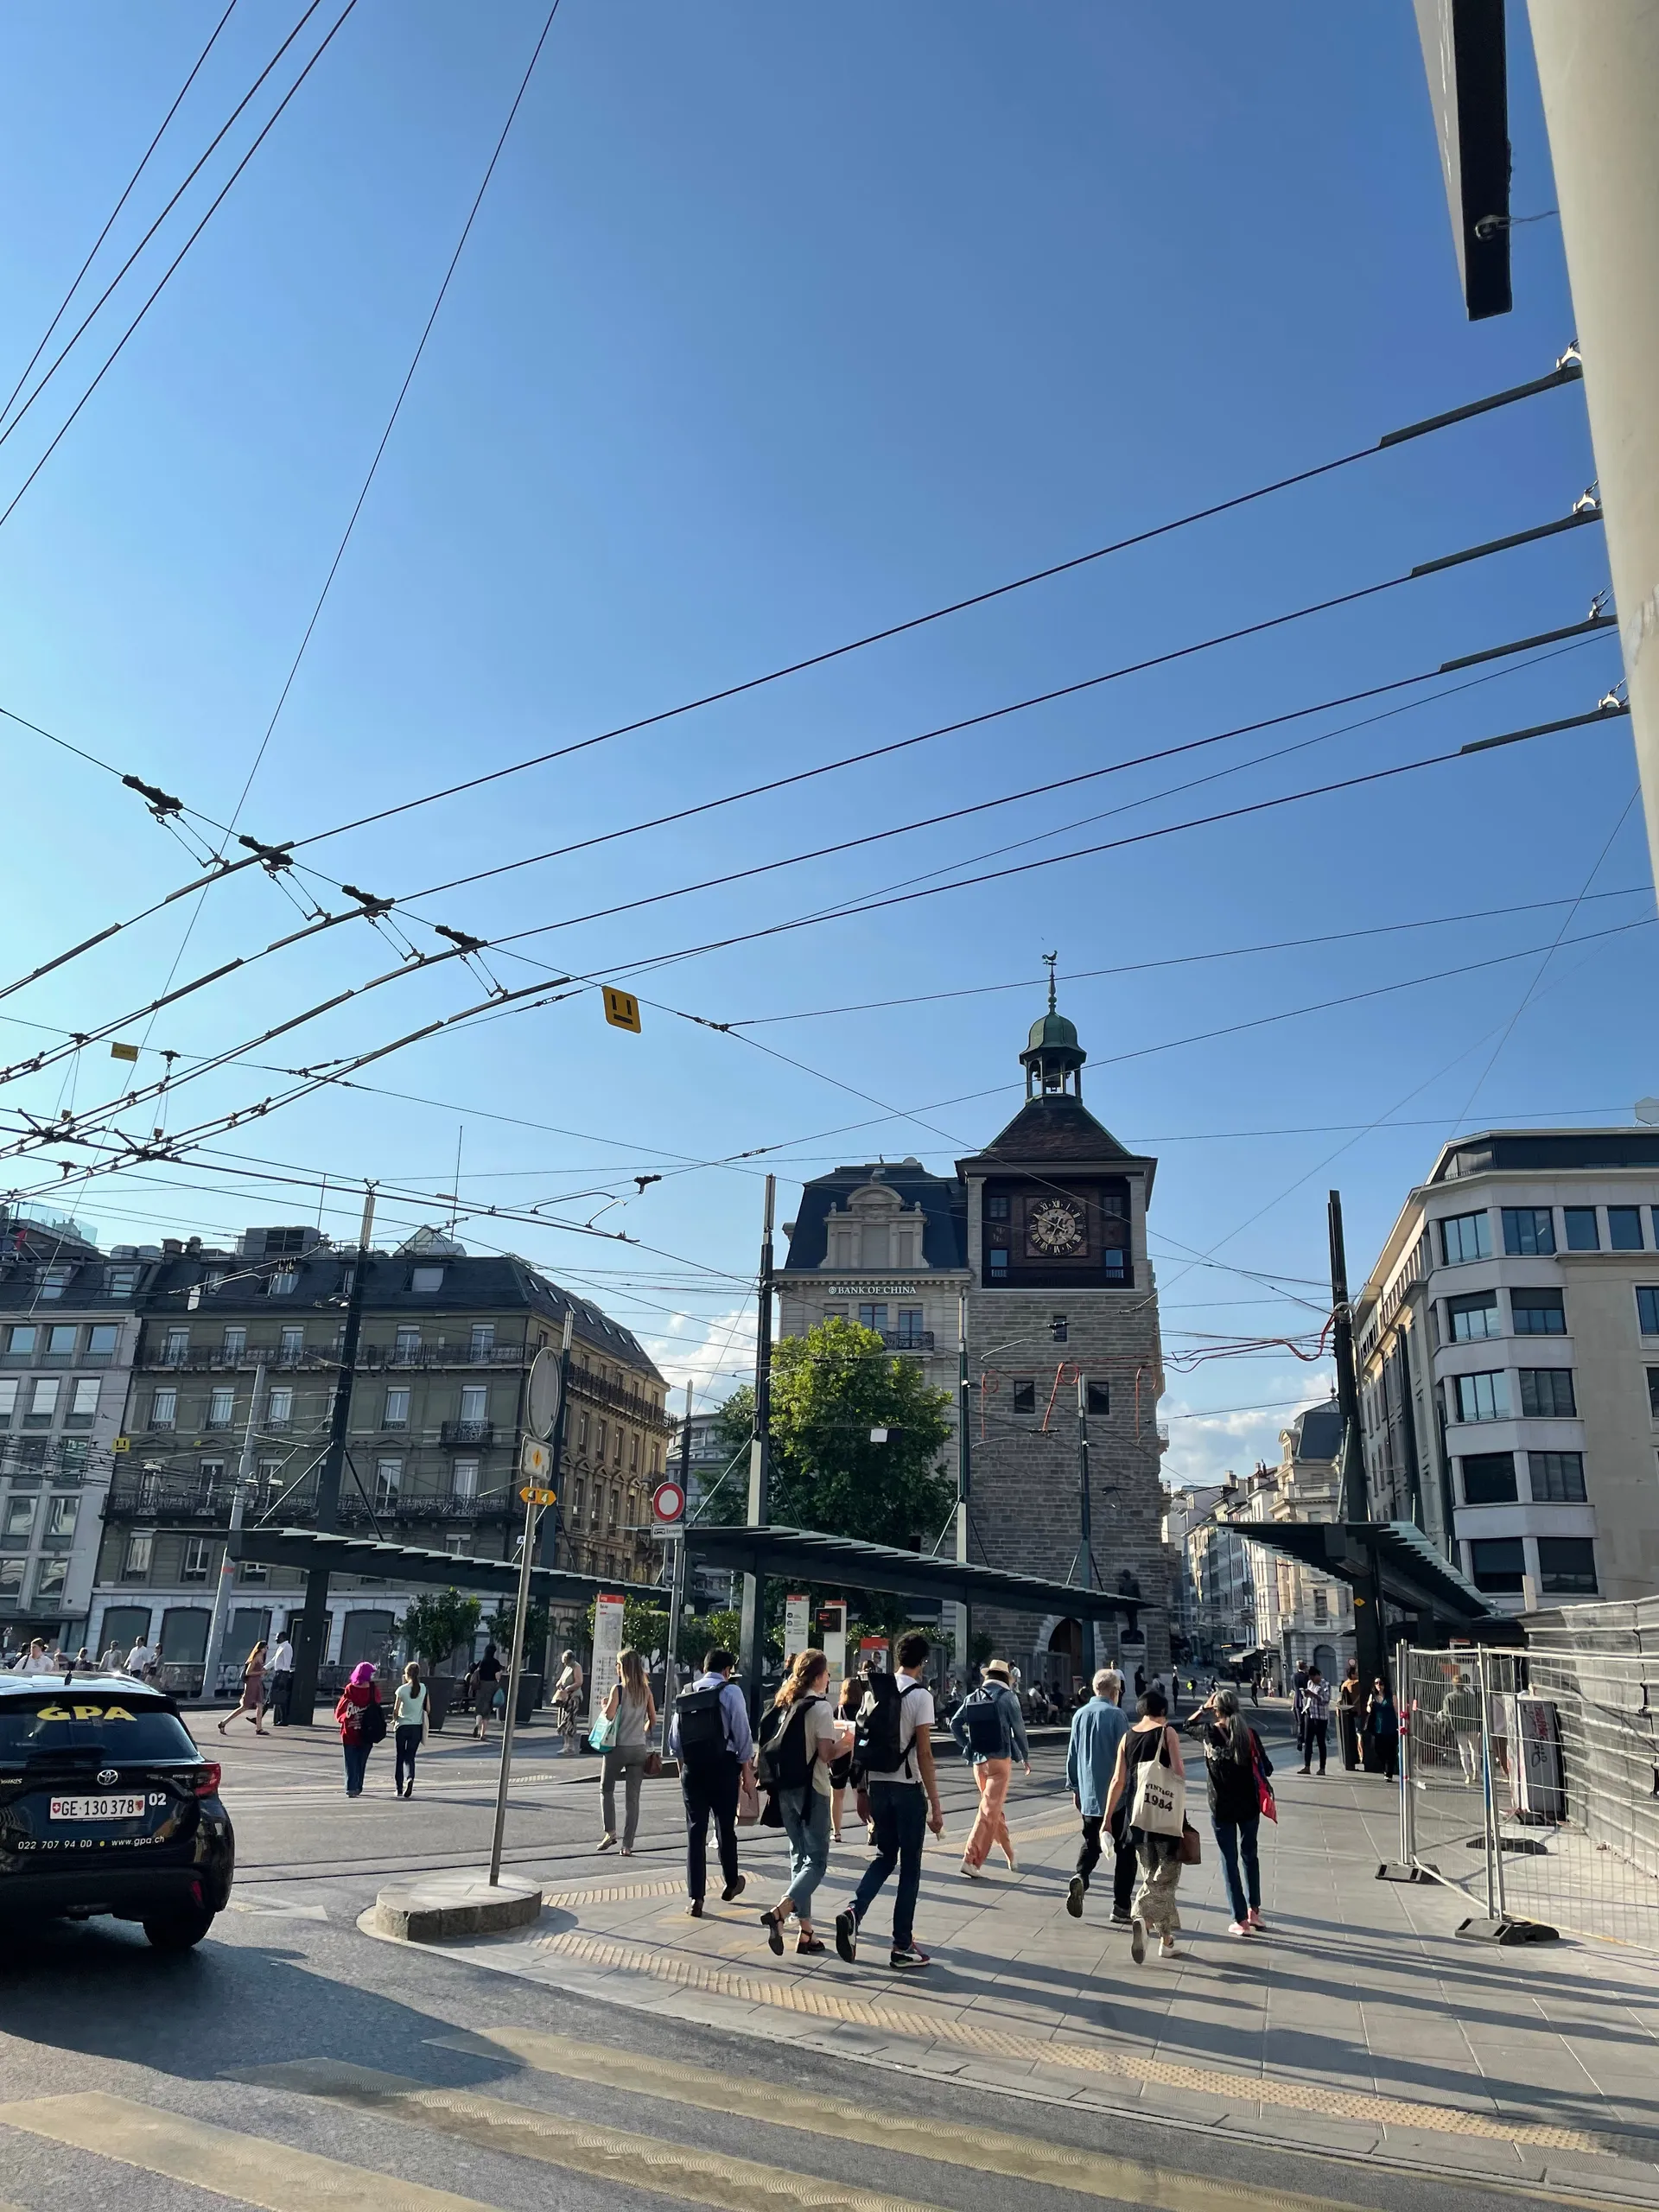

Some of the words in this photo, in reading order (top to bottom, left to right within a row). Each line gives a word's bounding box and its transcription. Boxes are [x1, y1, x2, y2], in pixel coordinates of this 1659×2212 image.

[838, 1286, 865, 1294] BANK
[868, 1286, 881, 1294] OF
[883, 1286, 917, 1294] CHINA
[37, 1706, 137, 1721] GPA
[1145, 1783, 1174, 1798] VINTAGE
[149, 1793, 167, 1806] 02
[1144, 1793, 1173, 1811] 1984
[18, 1840, 37, 1849] 022
[41, 1840, 60, 1849] 707
[64, 1840, 76, 1848] 94
[79, 1839, 92, 1847] 00
[111, 1834, 165, 1847] www.gpa.ch
